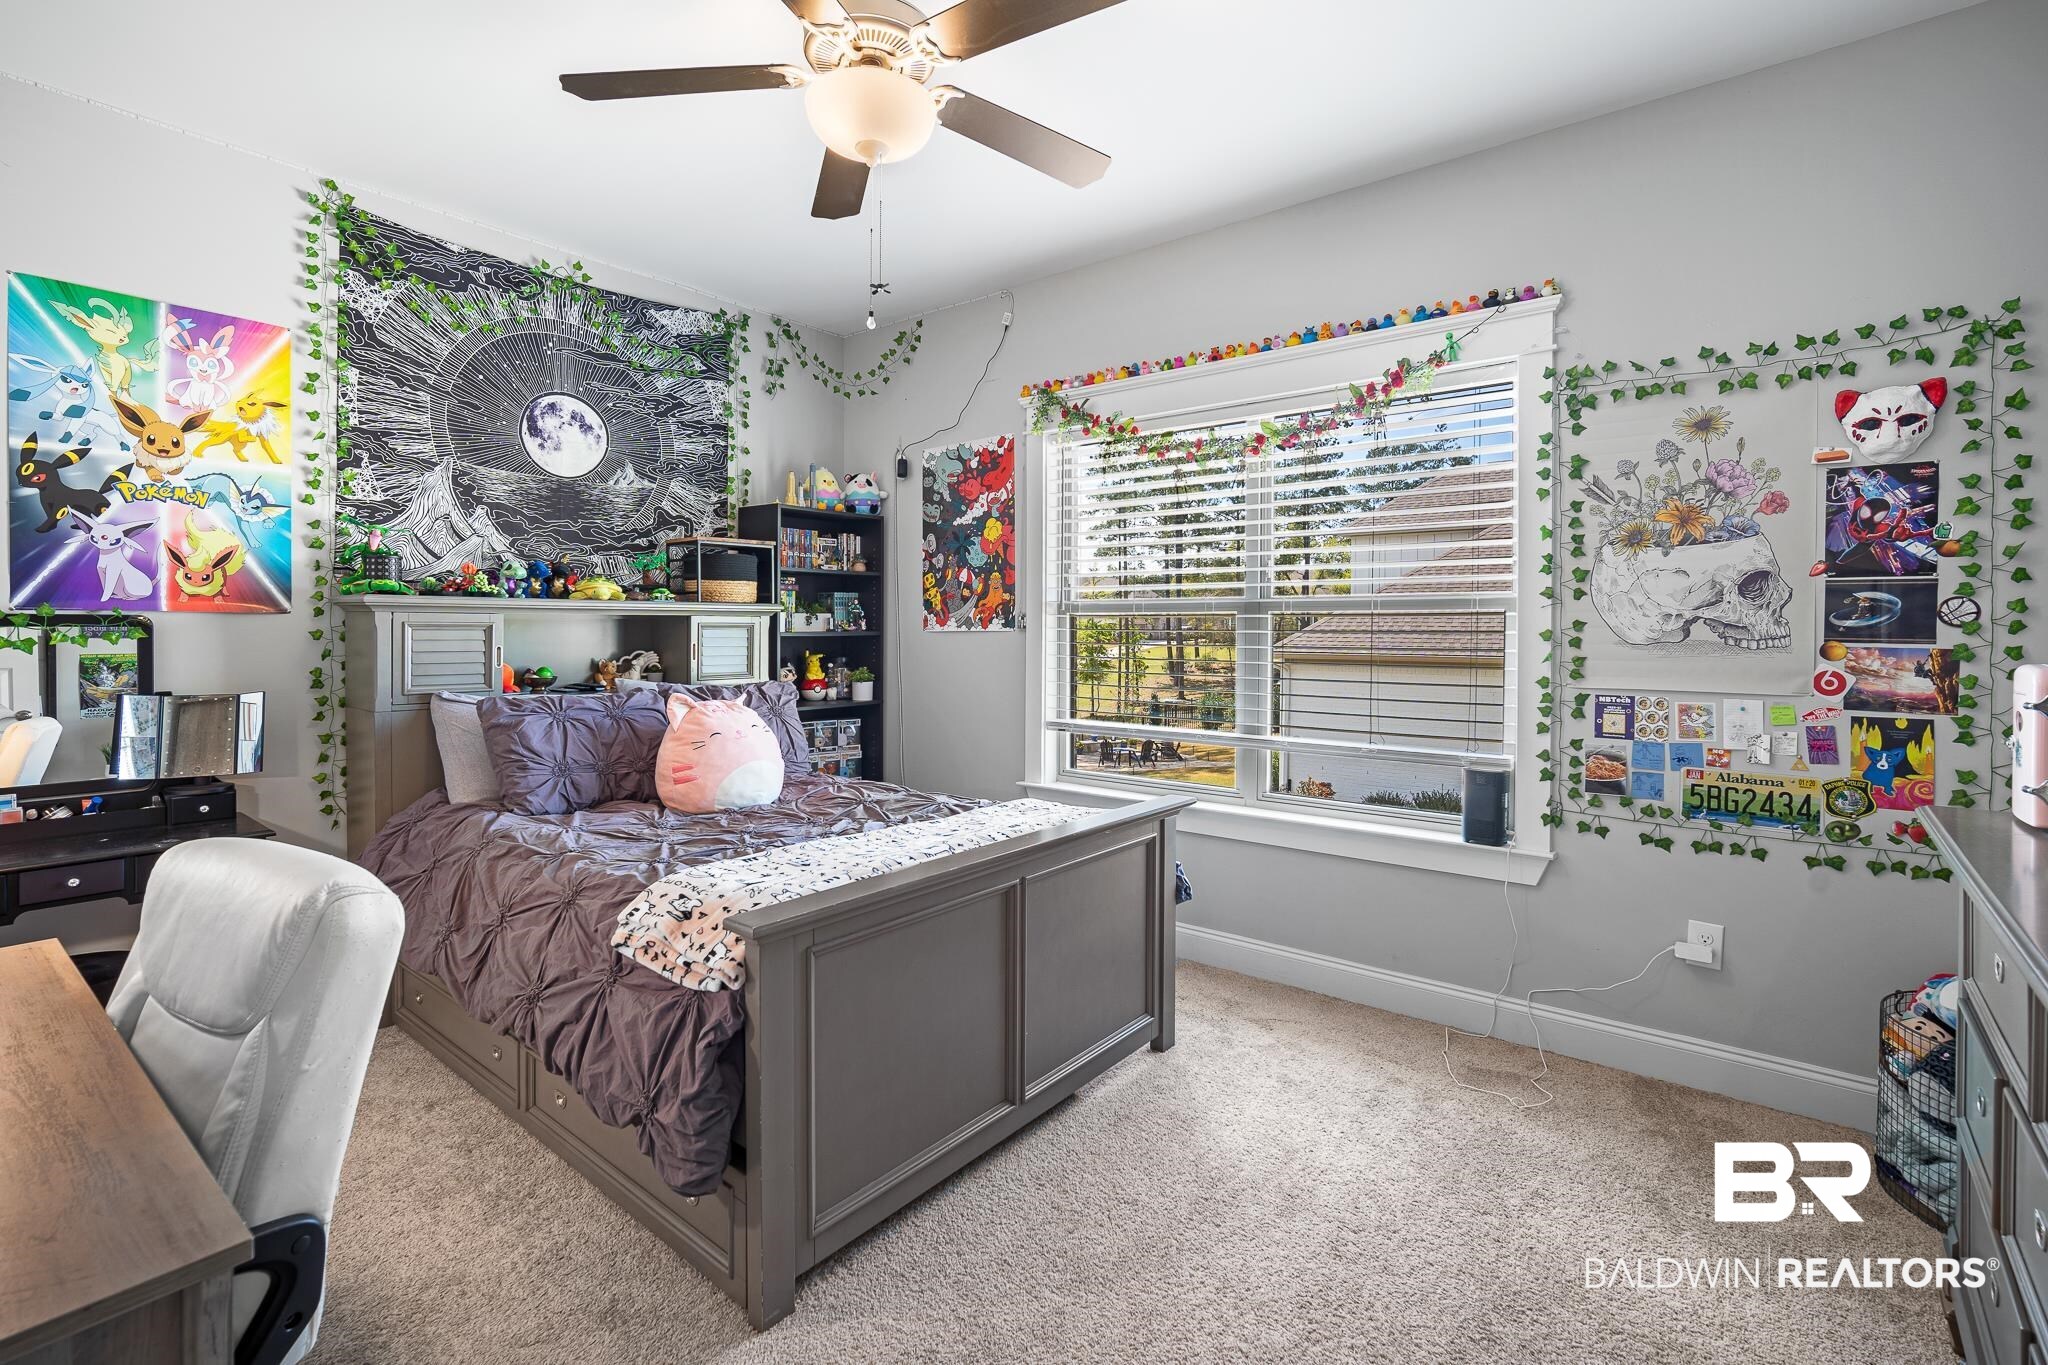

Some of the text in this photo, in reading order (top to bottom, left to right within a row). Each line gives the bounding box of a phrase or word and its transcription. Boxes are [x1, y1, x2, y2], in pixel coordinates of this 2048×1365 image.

[1599, 696, 1631, 704] NBTech
[1687, 770, 1701, 779] JAN
[1715, 772, 1784, 787] Alabama
[1690, 783, 1812, 820] 5BG2434
